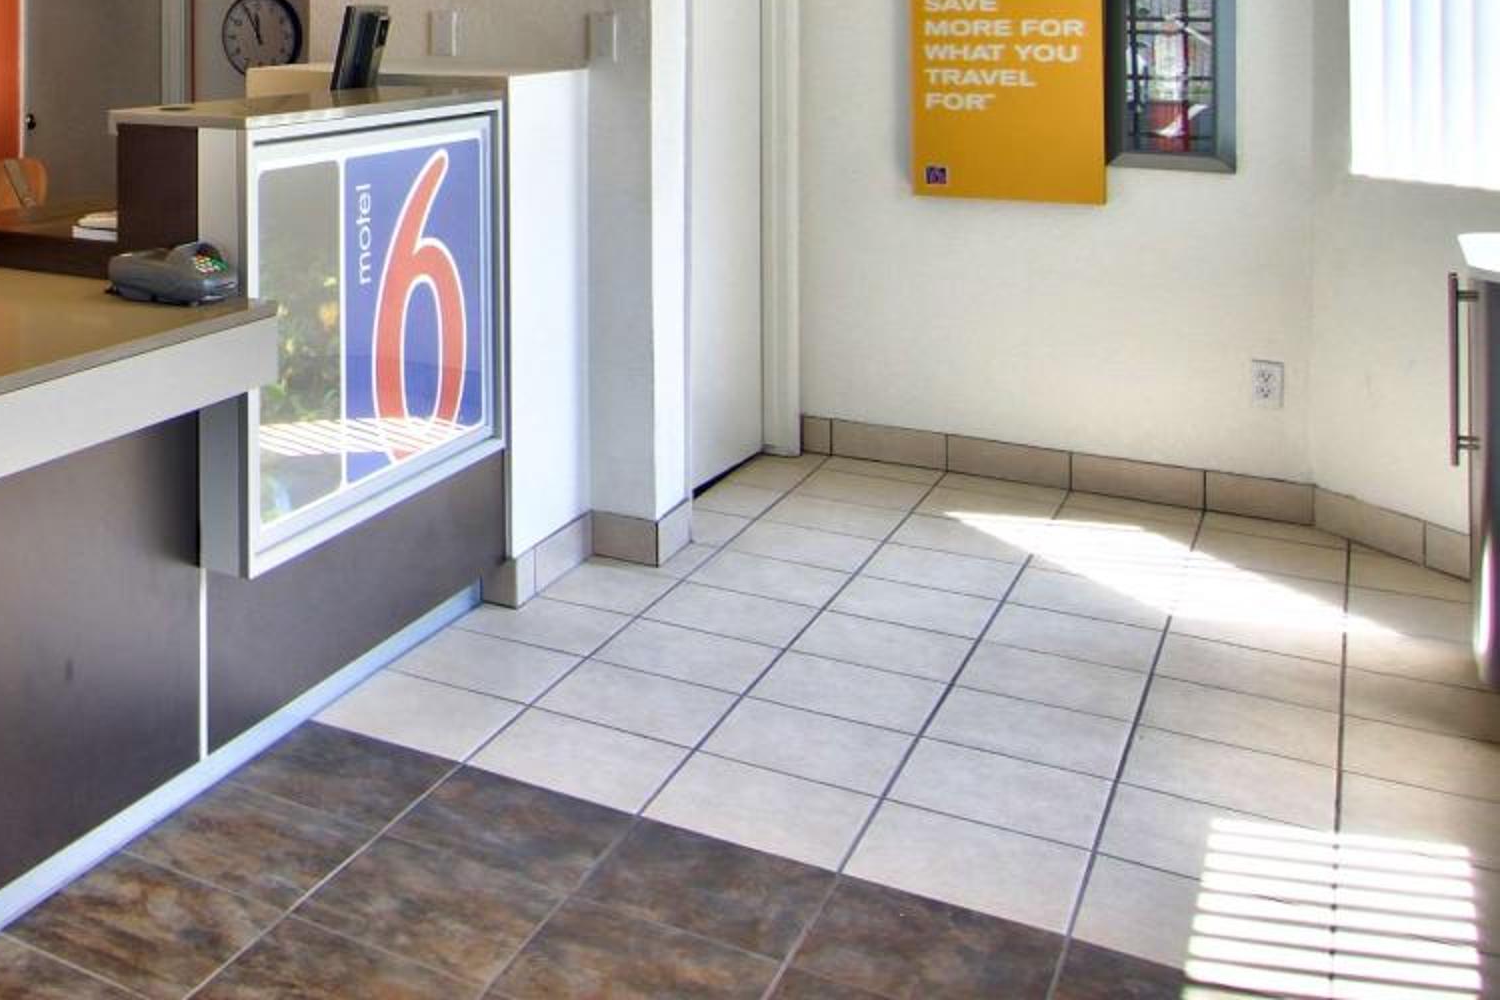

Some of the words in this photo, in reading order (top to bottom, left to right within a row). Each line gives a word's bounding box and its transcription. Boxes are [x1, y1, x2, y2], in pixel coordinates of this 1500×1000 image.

[925, 19, 1012, 37] MORE
[1021, 18, 1084, 38] FOR
[924, 44, 1004, 62] WHAT
[1014, 44, 1078, 63] YOU
[925, 68, 1037, 87] TRAVEL
[925, 92, 996, 111] FOR
[355, 183, 371, 285] motel
[371, 148, 467, 463] 6
